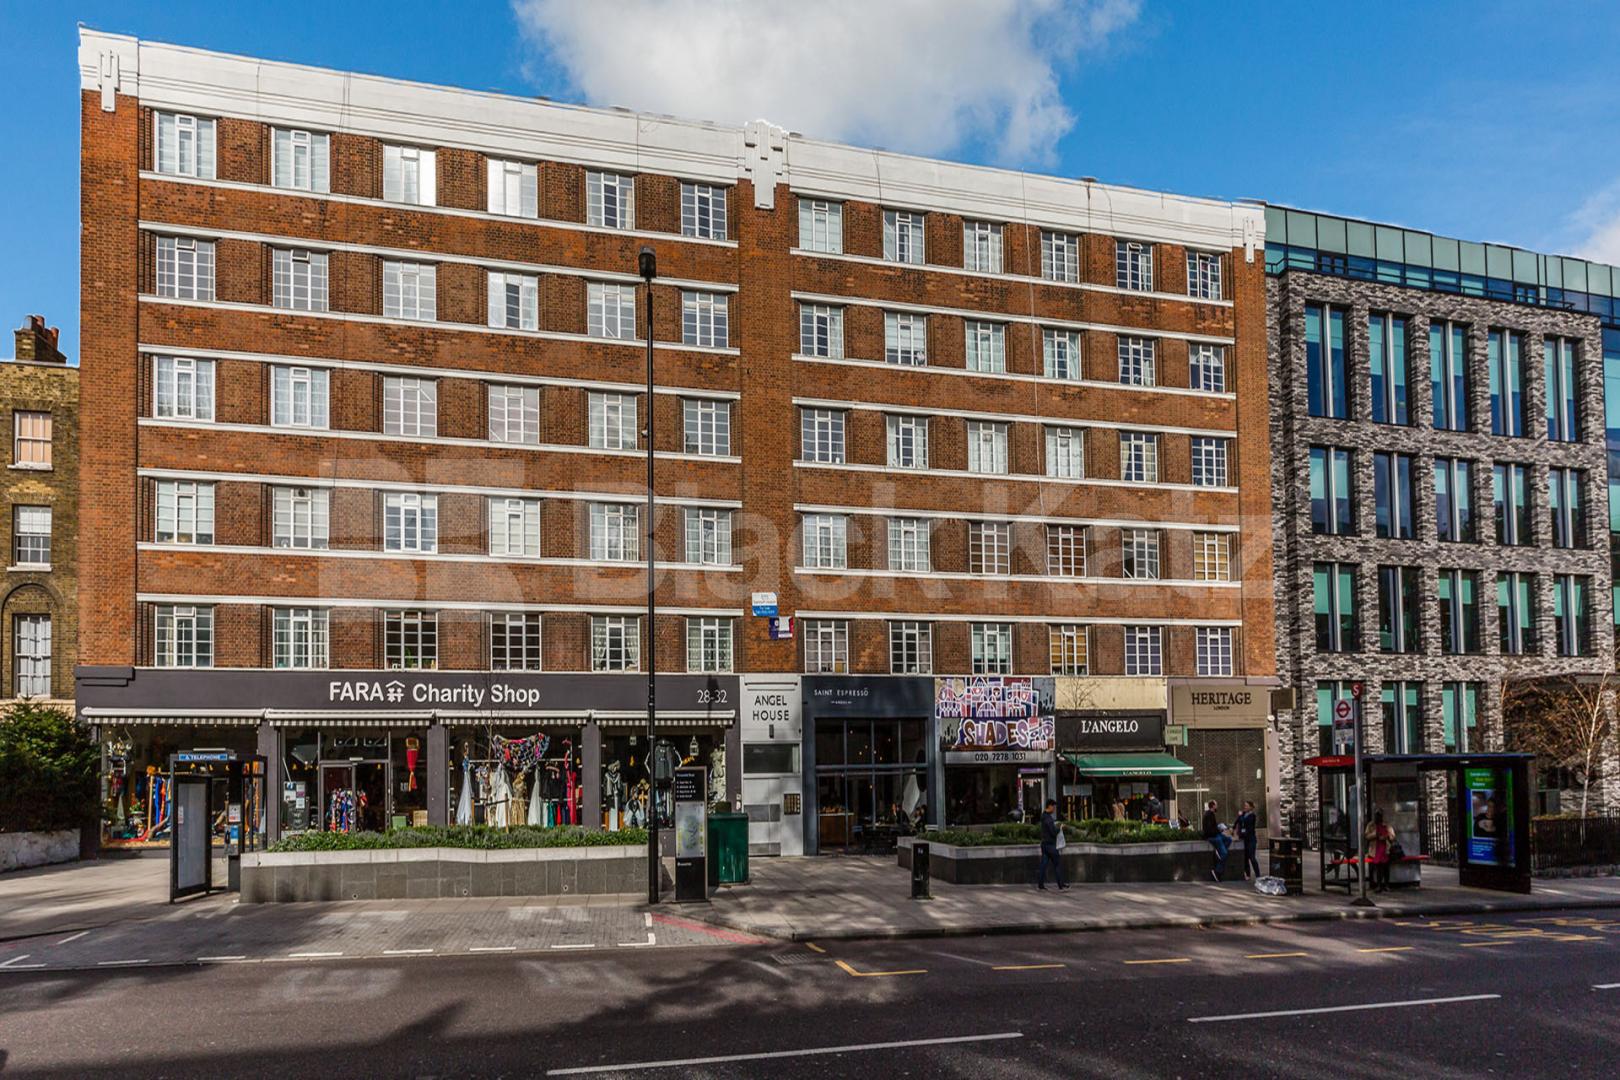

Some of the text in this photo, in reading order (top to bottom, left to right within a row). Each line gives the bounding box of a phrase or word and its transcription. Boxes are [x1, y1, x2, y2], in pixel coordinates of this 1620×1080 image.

[329, 681, 541, 707] FARA Charity Shop
[697, 689, 728, 704] 28-32
[814, 689, 833, 697] SAINT
[1191, 692, 1252, 705] HERITAGE
[754, 694, 787, 706] ANGEL
[752, 710, 790, 721] HOUSE
[963, 719, 1030, 748] SHADES
[1081, 720, 1139, 734] L'ANGELO
[974, 753, 1026, 761] 020 7278 1031
